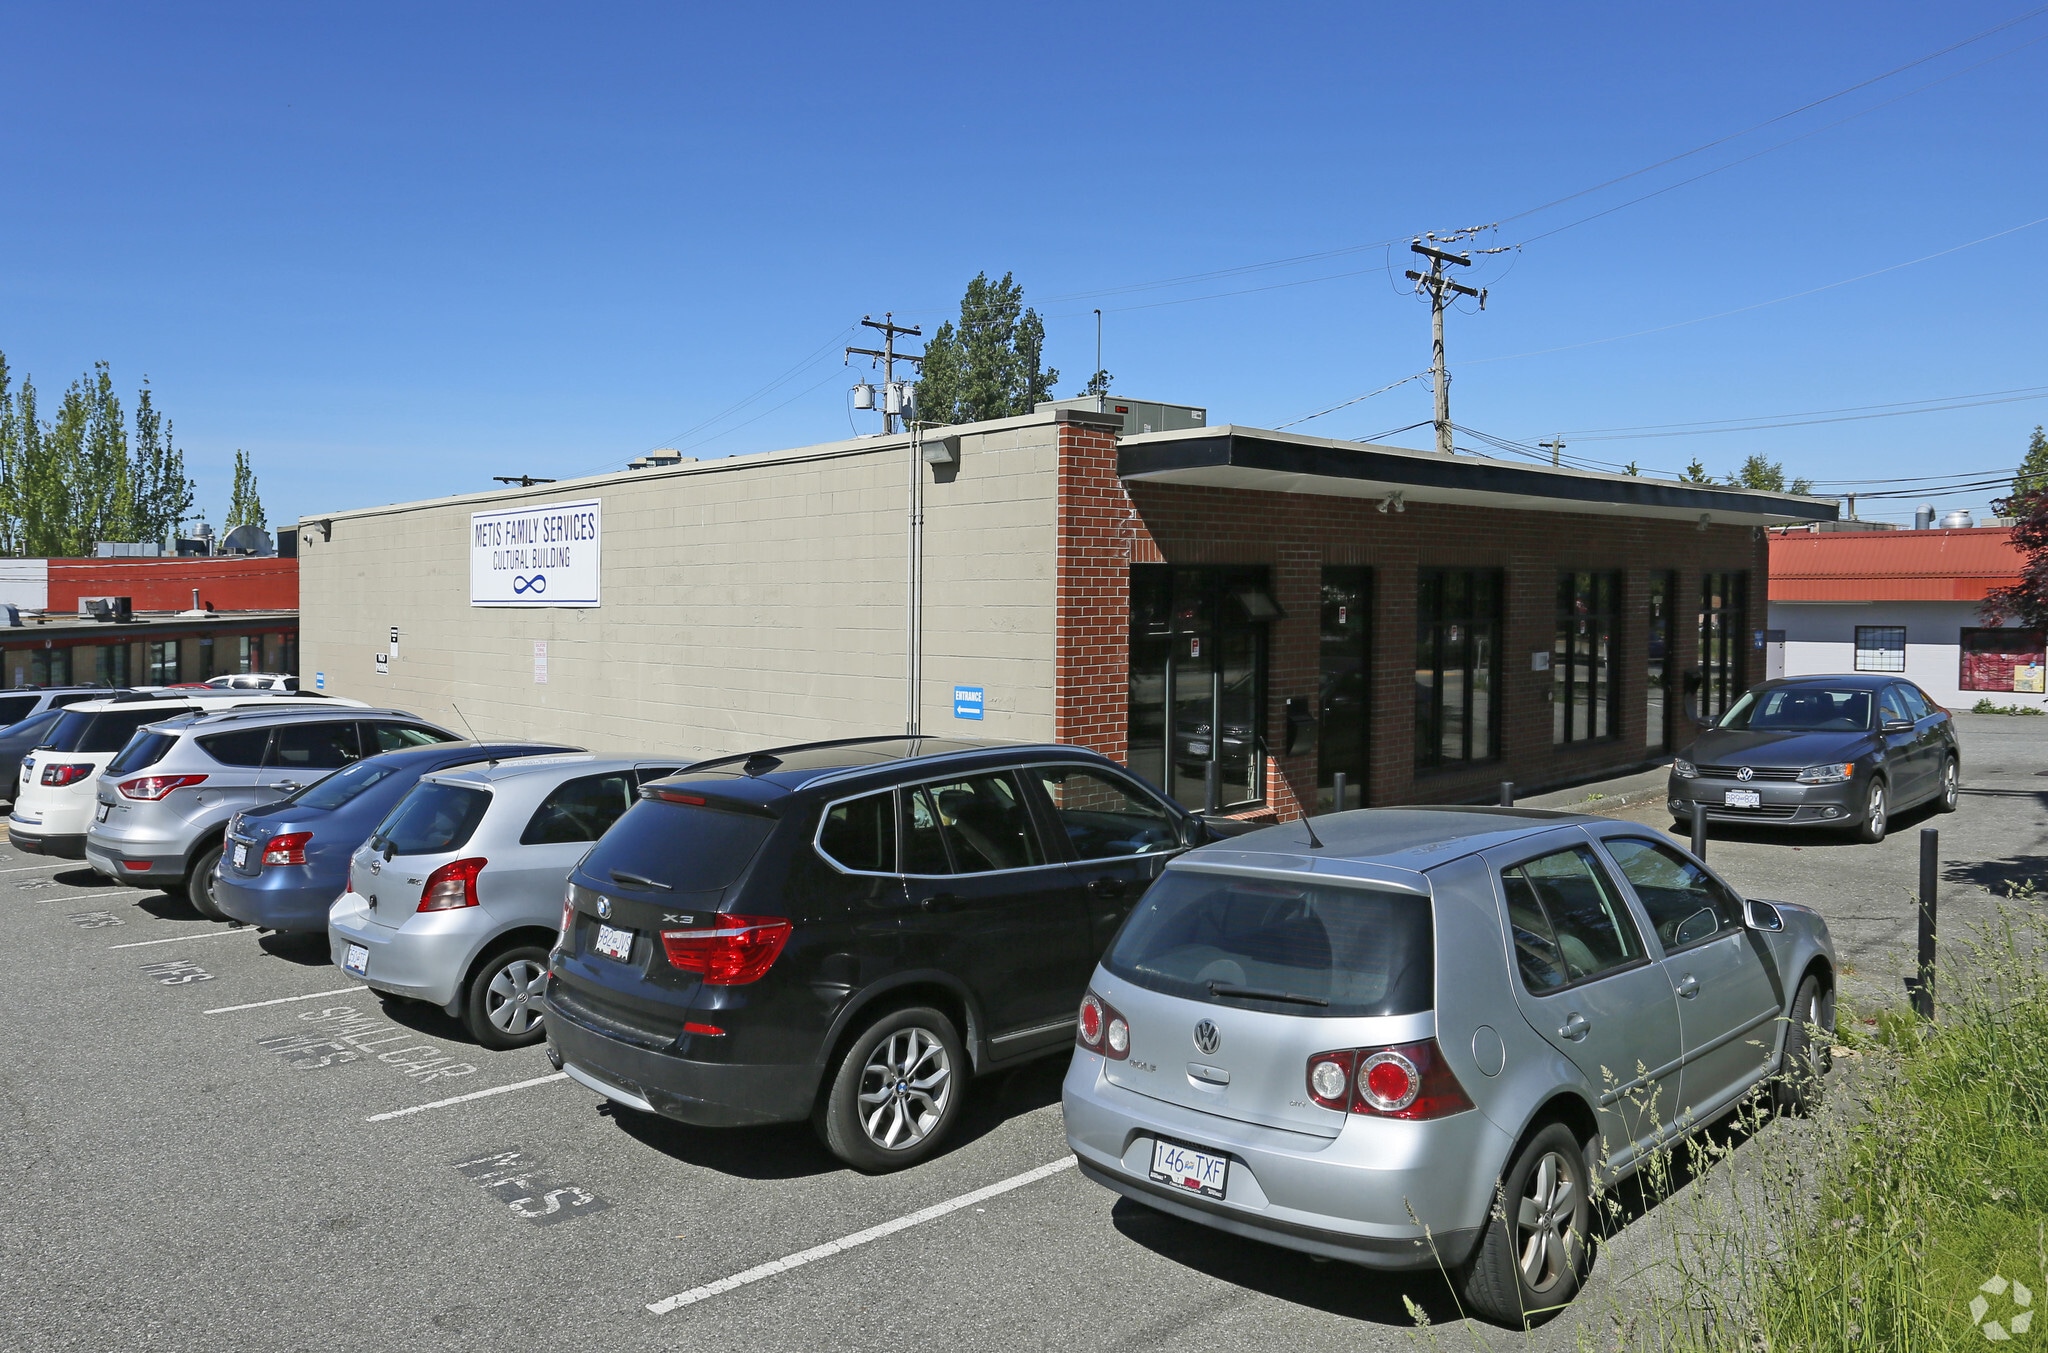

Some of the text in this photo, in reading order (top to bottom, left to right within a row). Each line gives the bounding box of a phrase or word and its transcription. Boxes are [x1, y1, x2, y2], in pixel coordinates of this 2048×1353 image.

[475, 512, 595, 547] METIS FAMILY SERVICES
[493, 546, 570, 570] CULTURAL BUILDING
[955, 690, 982, 702] ENTRANCE
[662, 913, 694, 924] X3
[139, 959, 215, 985] MFS
[258, 1036, 360, 1070] MFS
[298, 1006, 478, 1085] SMALL CAR
[1158, 1145, 1225, 1184] 146 TXF
